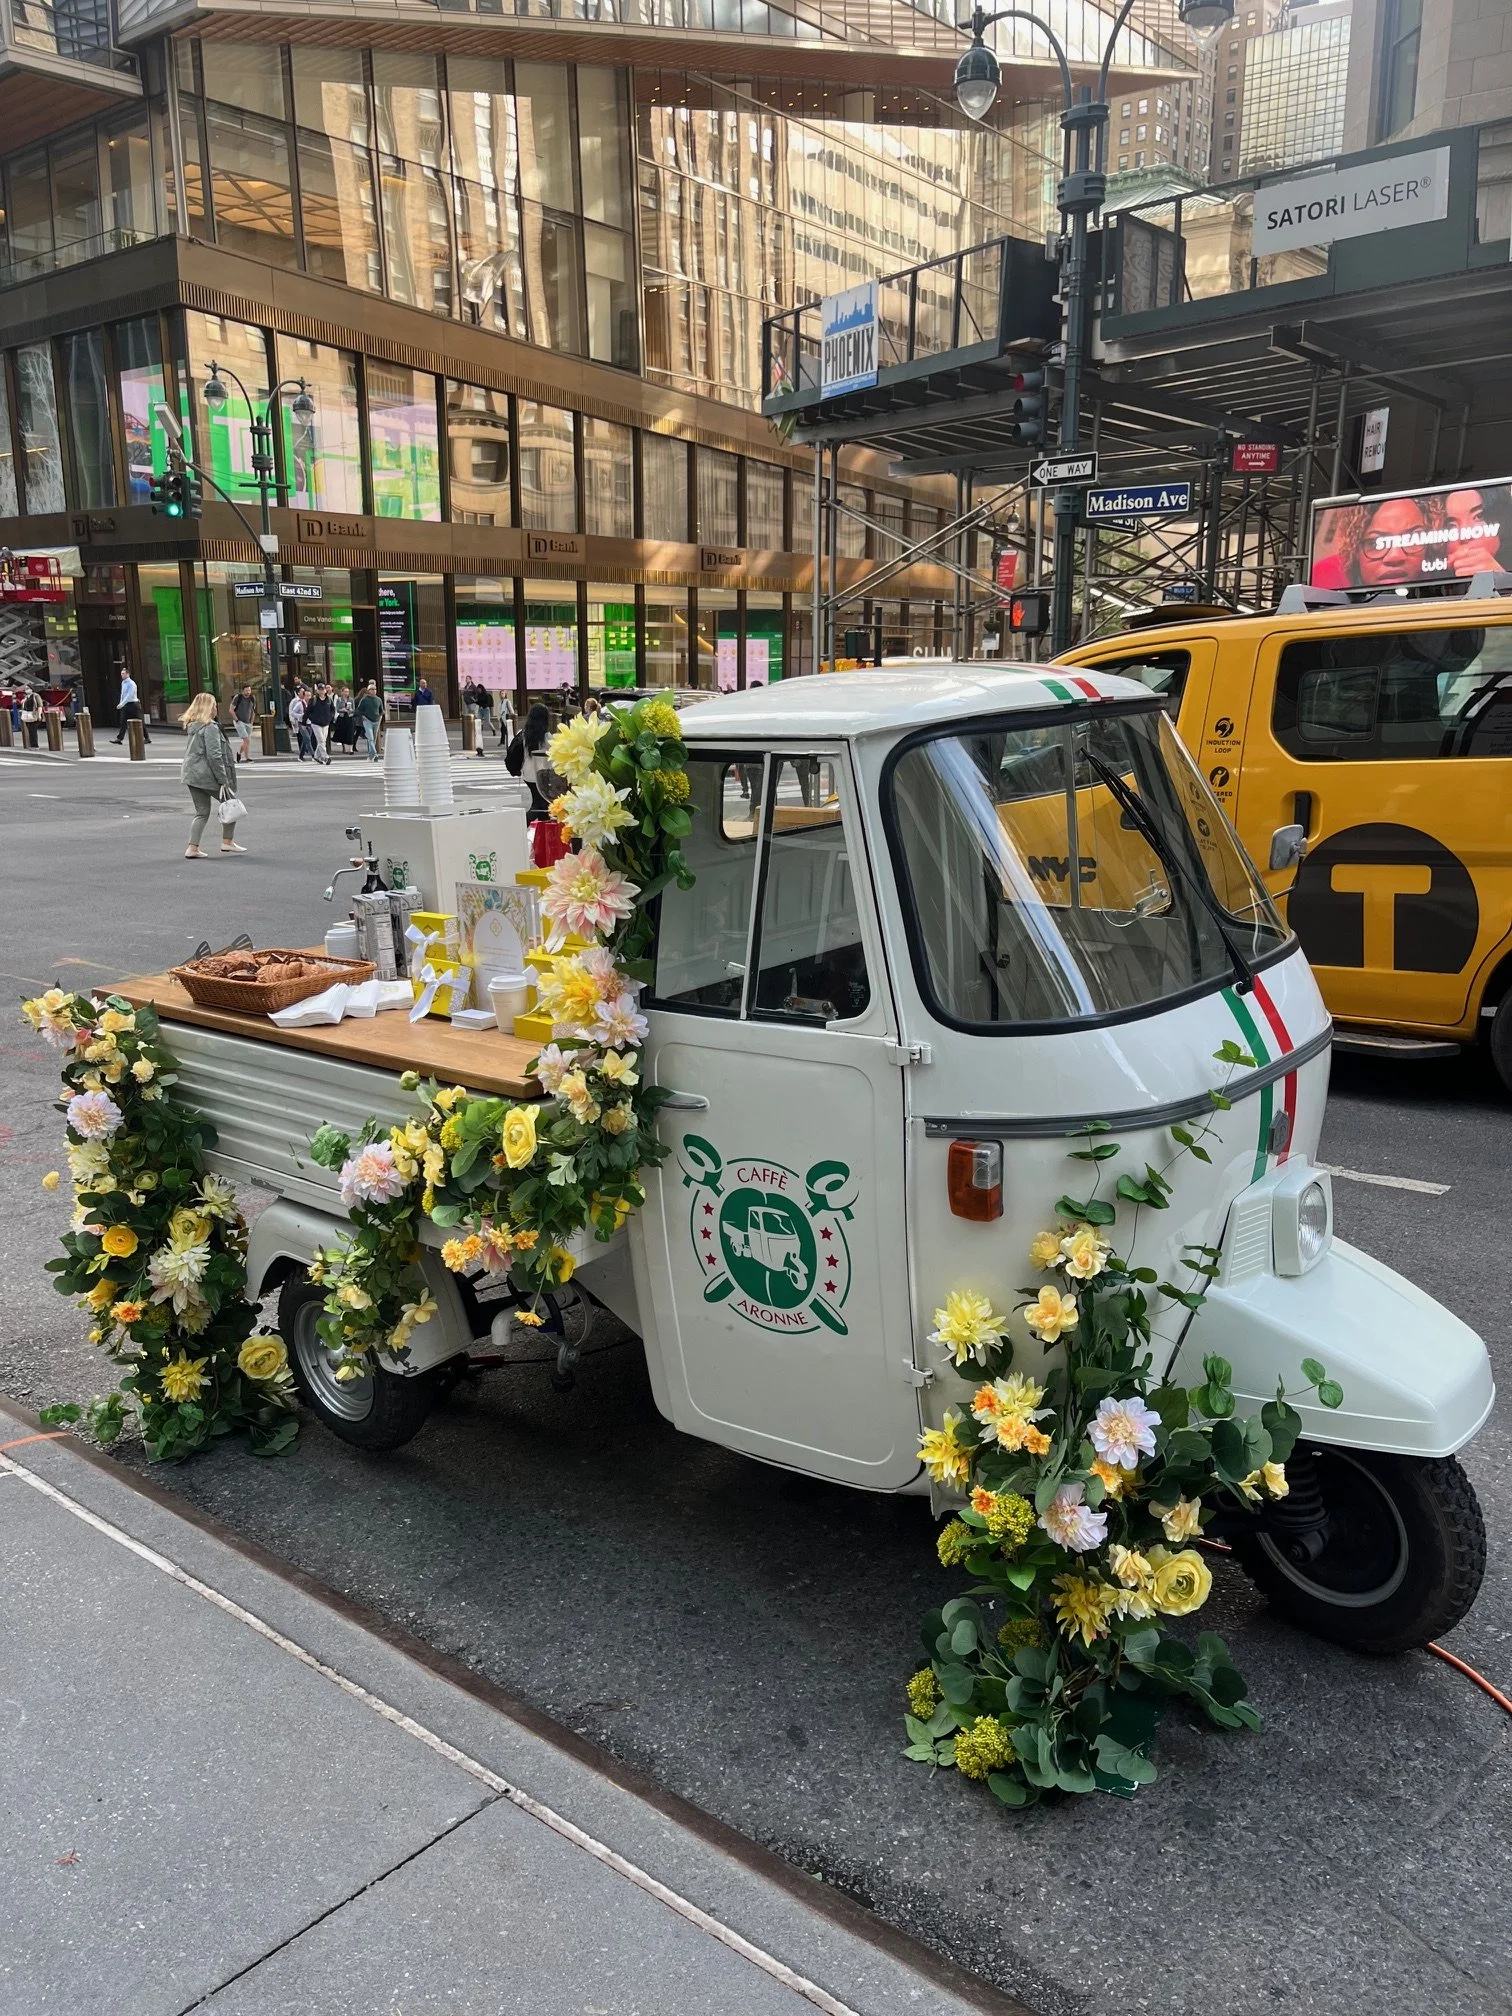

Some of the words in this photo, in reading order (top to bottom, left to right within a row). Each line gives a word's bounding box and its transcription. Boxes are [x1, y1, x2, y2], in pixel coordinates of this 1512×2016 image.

[1267, 196, 1346, 231] SATORI
[824, 326, 875, 385] PHOENIX
[1366, 421, 1382, 438] HAIR
[1241, 452, 1271, 460] ANYTIME
[1039, 466, 1058, 479] ONE
[1067, 462, 1088, 476] WAY
[1088, 493, 1154, 513] Madison
[1157, 490, 1188, 508] Ave
[328, 521, 367, 537] Bank
[1375, 527, 1460, 551] STREAMING
[1460, 522, 1501, 541] NOW
[550, 538, 578, 554] Bank
[718, 553, 742, 566] Bank
[1421, 557, 1448, 572] tubi
[235, 586, 255, 595] Madison
[281, 585, 296, 595] East
[297, 587, 312, 596] 42nd
[313, 588, 320, 597] St
[303, 615, 316, 623] One
[1027, 855, 1097, 882] NYC
[1331, 864, 1432, 968] T
[737, 1167, 789, 1191] CAFFÈ
[737, 1299, 809, 1326] ARONNE
